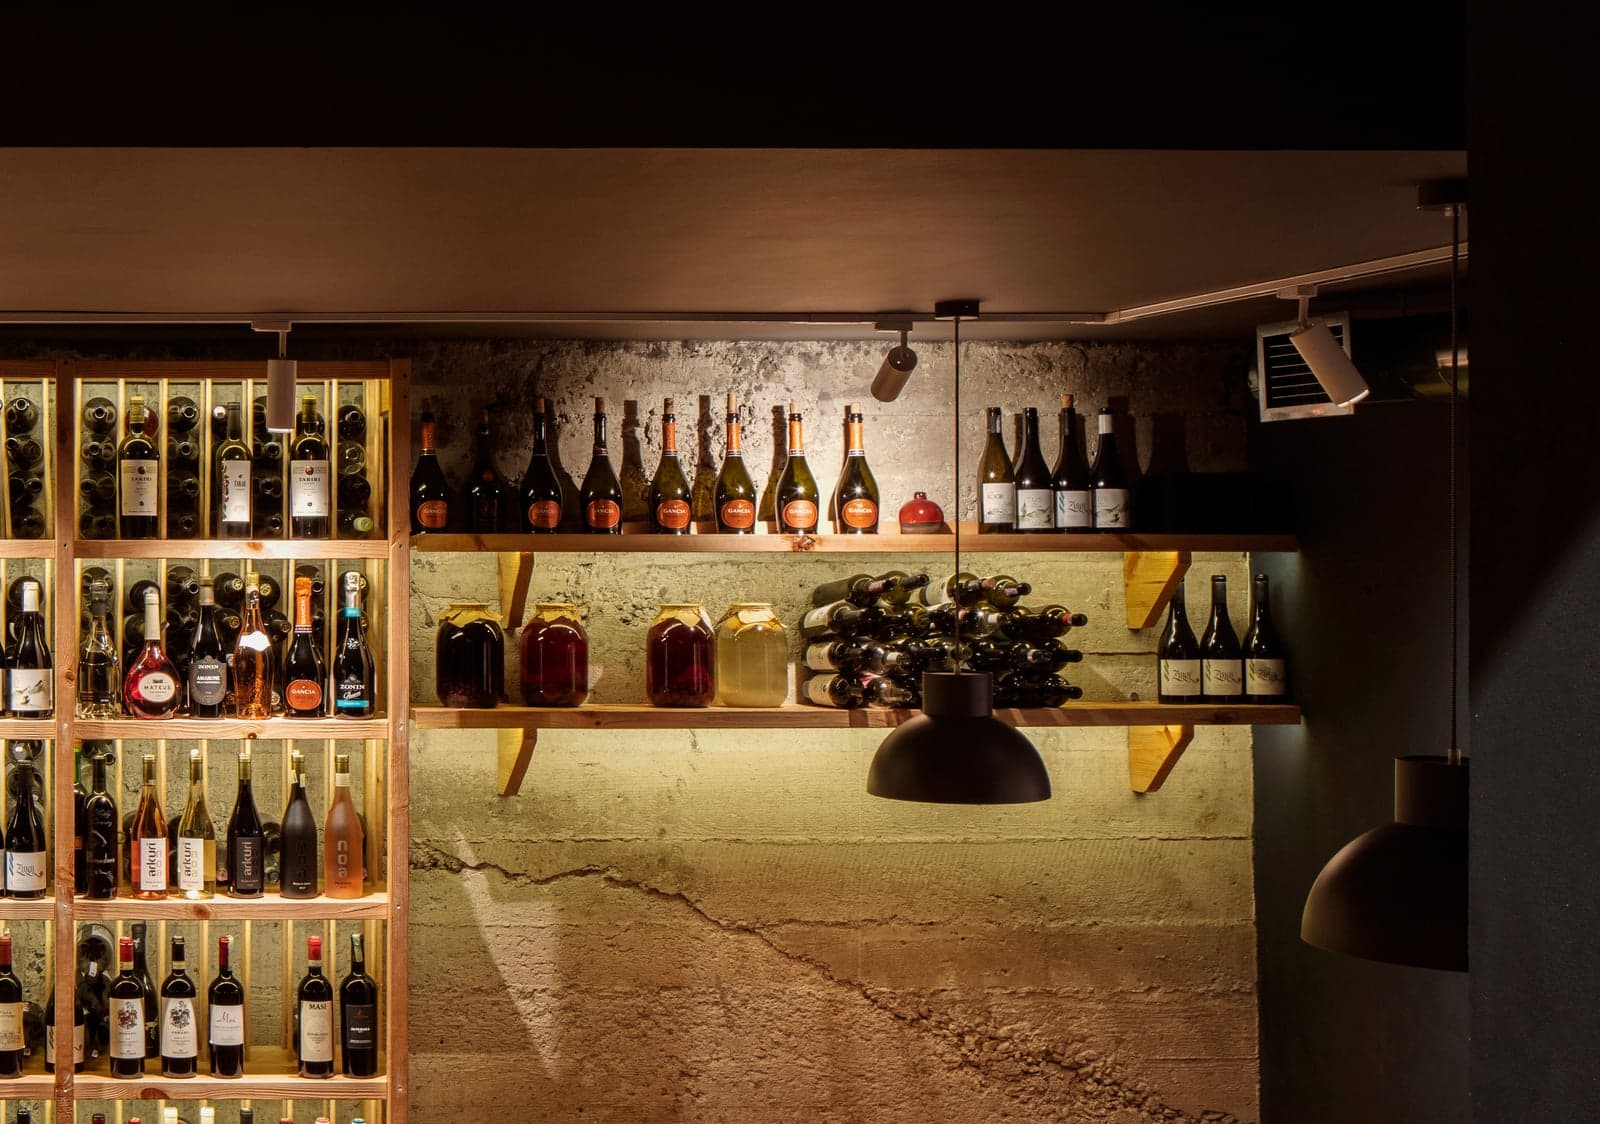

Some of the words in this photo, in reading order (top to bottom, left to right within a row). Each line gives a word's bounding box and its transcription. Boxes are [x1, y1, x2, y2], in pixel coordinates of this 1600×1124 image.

[146, 842, 156, 877] arkuri
[184, 842, 192, 877] arkuri
[242, 841, 253, 877] arkuri
[337, 840, 348, 878] noa
